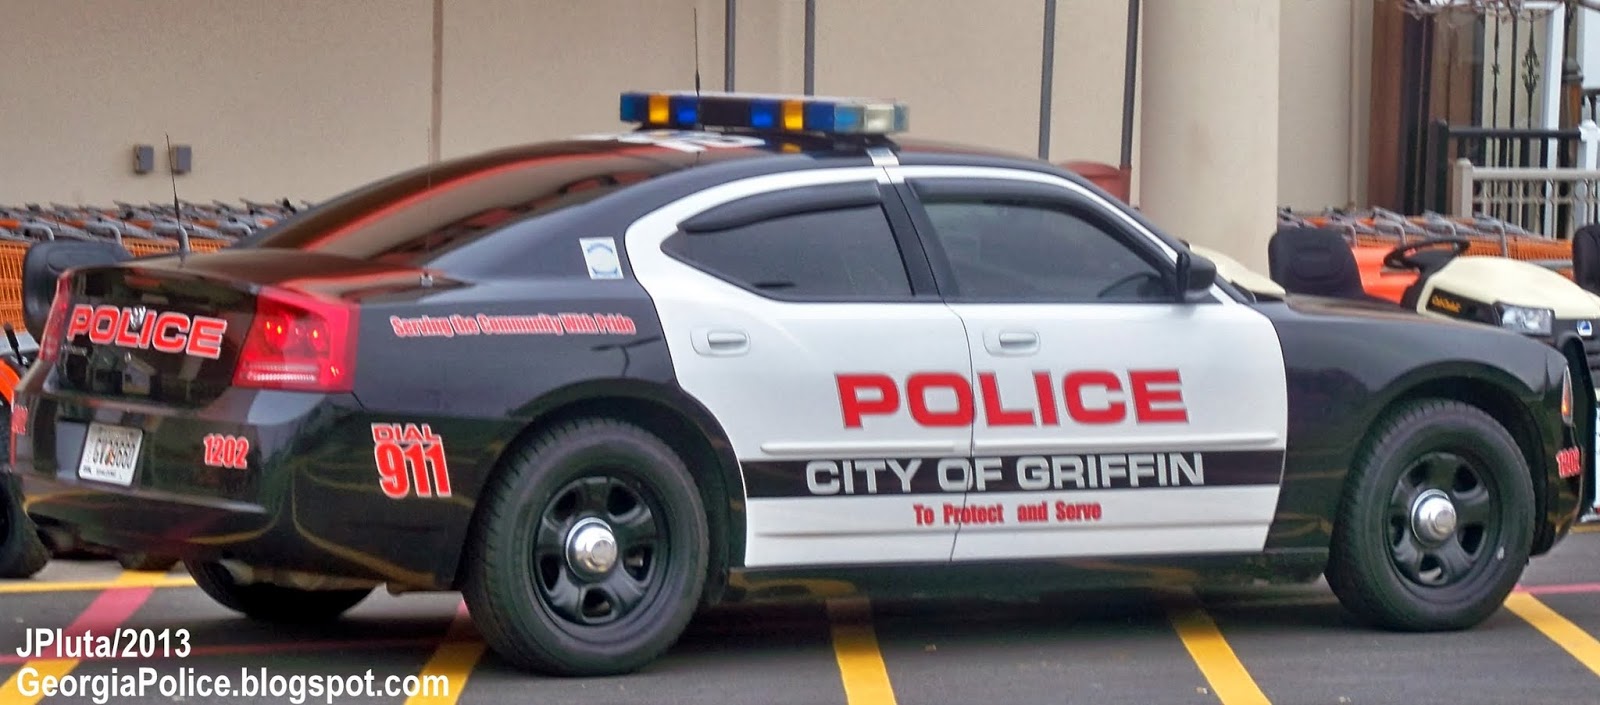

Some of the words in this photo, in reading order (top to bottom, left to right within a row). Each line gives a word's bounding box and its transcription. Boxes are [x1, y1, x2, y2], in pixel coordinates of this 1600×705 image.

[67, 304, 228, 360] POLICE
[834, 368, 1190, 429] POLICE
[203, 433, 250, 470] 1202
[371, 422, 443, 444] DIAL
[374, 441, 452, 499] 911
[806, 459, 923, 496] CITY
[937, 457, 1003, 492] OF
[1016, 453, 1206, 491] GRIFFIN
[913, 503, 935, 525] To
[943, 502, 1005, 525] Protect
[1017, 501, 1049, 523] and
[1055, 500, 1103, 522] Serve
